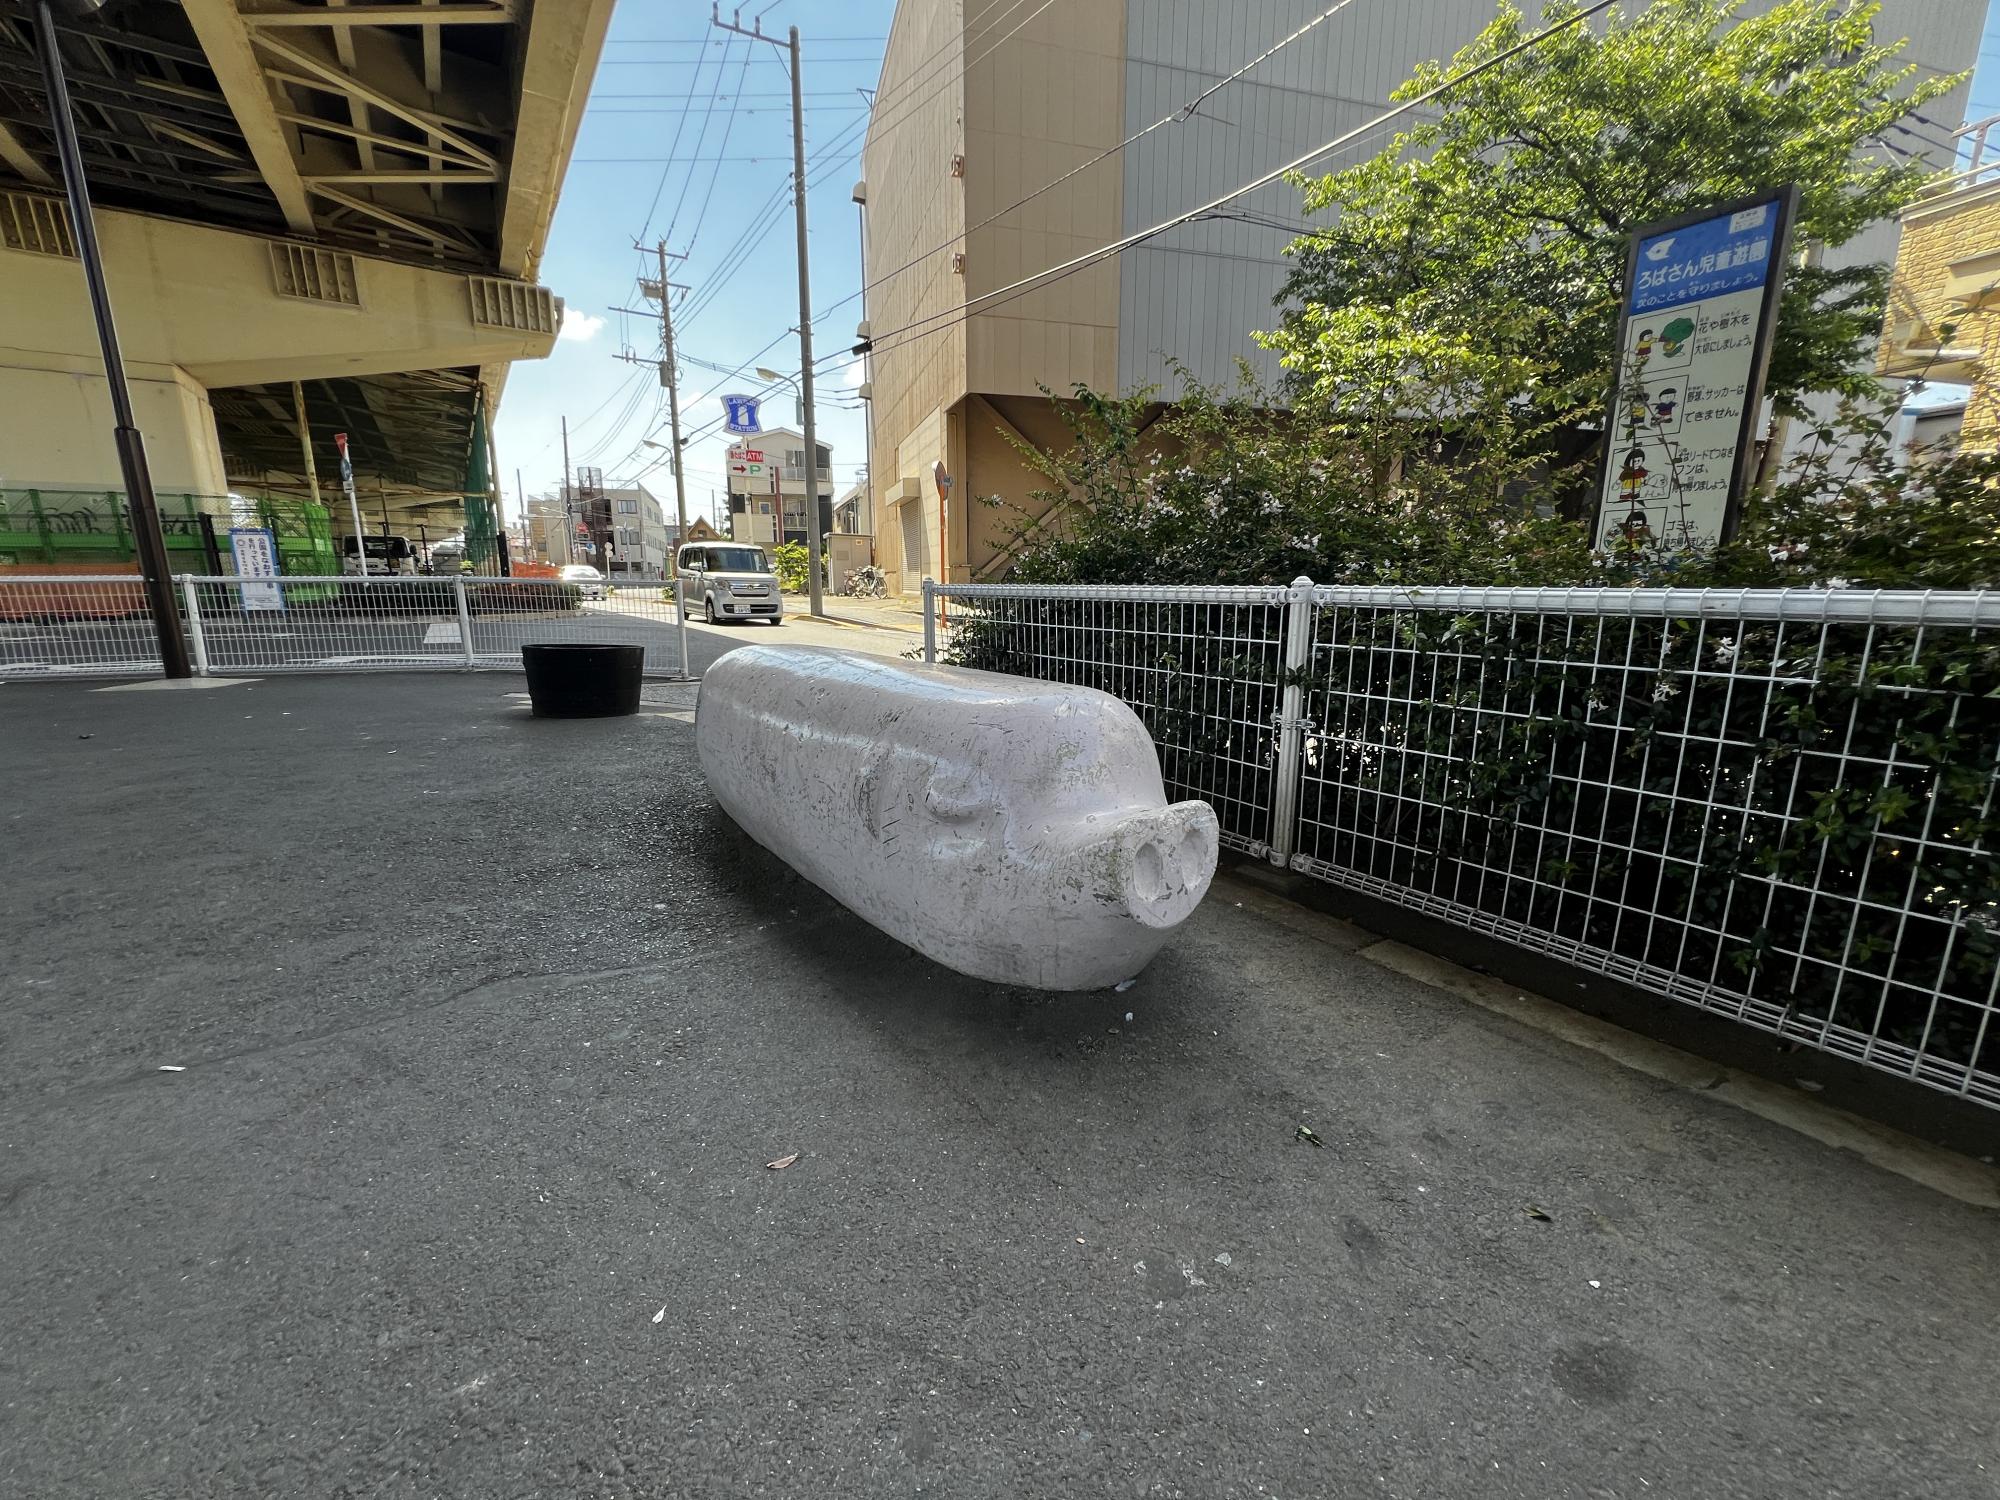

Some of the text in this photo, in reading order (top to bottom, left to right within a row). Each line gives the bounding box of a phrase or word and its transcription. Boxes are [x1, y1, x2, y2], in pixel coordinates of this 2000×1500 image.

[1638, 240, 1767, 289] ろばさん児童遊園
[1699, 314, 1751, 334] 花や樹木を
[1684, 407, 1739, 423] できません。
[746, 452, 764, 461] ATM
[749, 464, 762, 475] P
